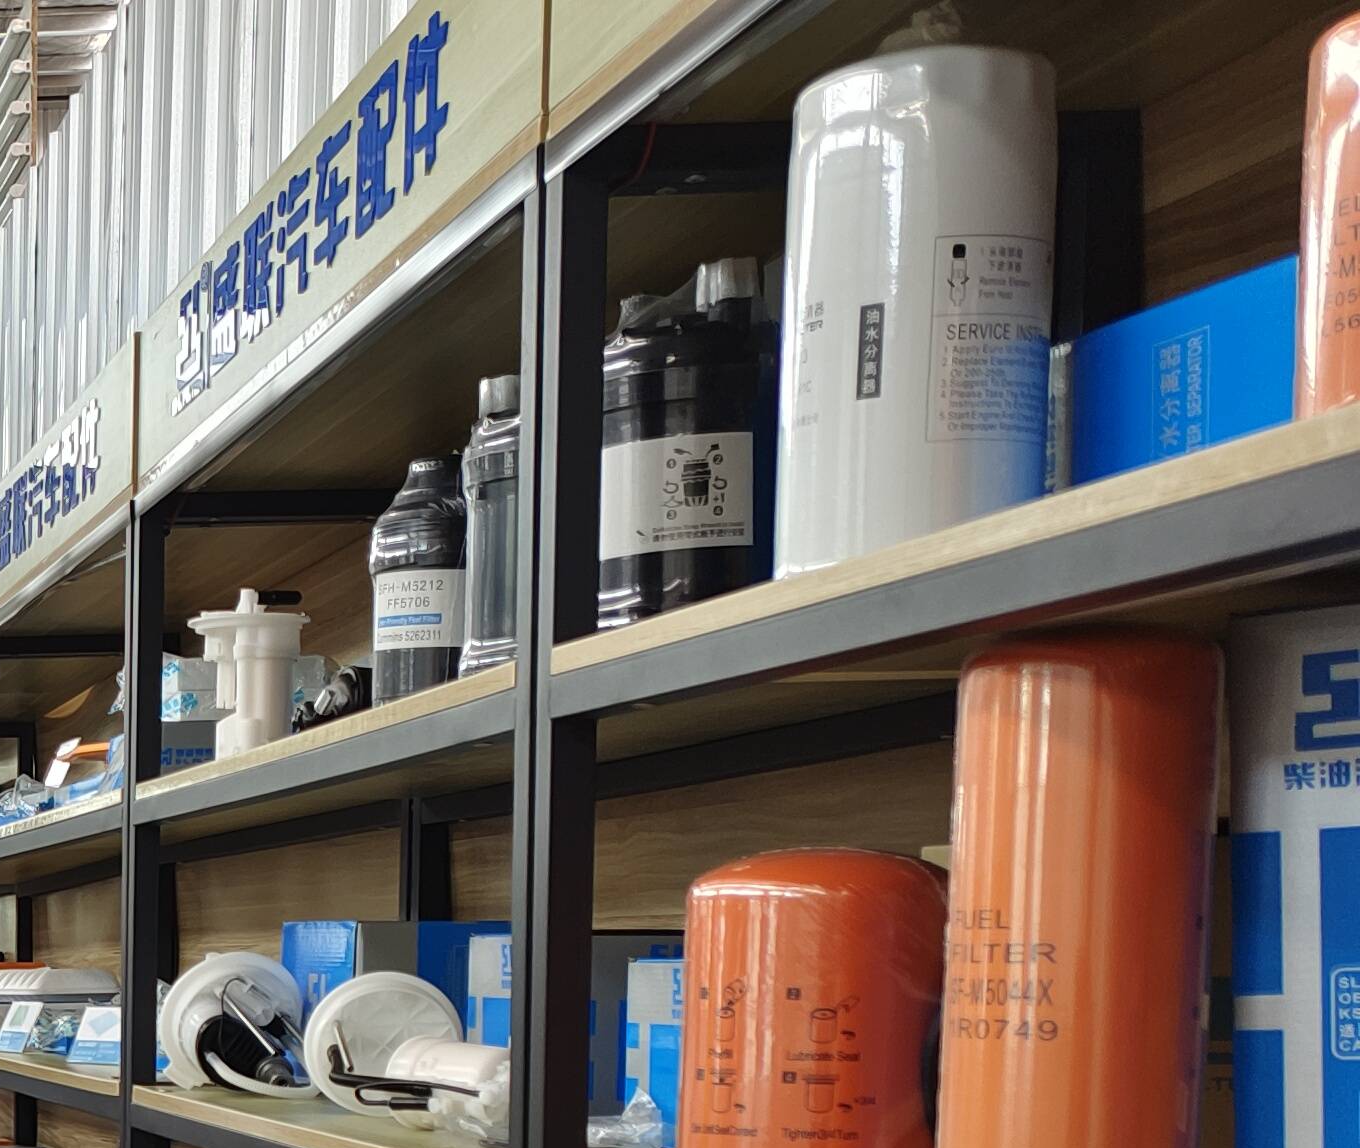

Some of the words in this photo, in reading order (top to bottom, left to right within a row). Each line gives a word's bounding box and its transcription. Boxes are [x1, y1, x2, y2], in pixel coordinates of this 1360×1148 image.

[211, 10, 450, 377] 盛联汽车配件
[946, 323, 1011, 340] SERVICE
[862, 308, 881, 395] 油水分离器
[387, 596, 431, 611] FF5706
[404, 629, 442, 642] 5262311
[1283, 757, 1360, 790] 柴油
[955, 909, 1011, 930] FUEL
[951, 943, 1057, 964] FILTER
